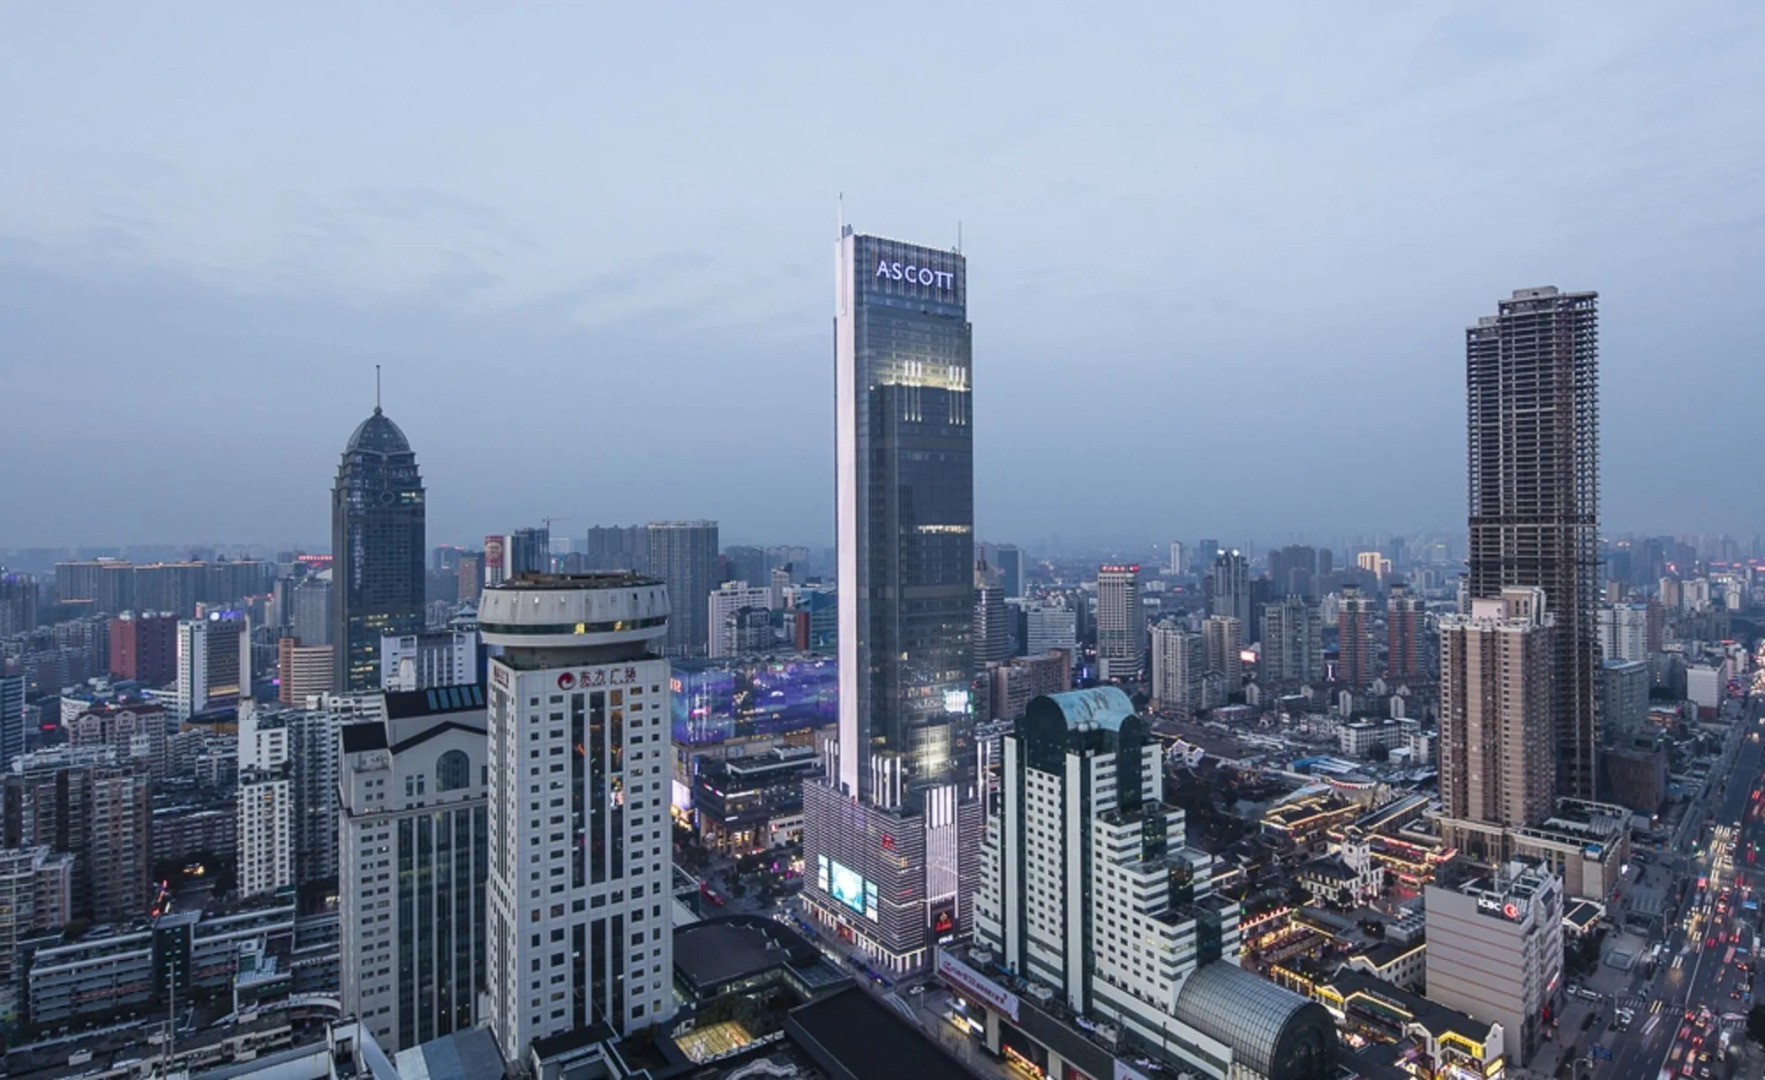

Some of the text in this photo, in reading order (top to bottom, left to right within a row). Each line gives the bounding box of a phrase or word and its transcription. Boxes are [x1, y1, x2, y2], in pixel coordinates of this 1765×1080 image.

[876, 260, 954, 290] ASCOTT
[579, 667, 637, 682] 东方广场
[1478, 898, 1501, 911] ICBC
